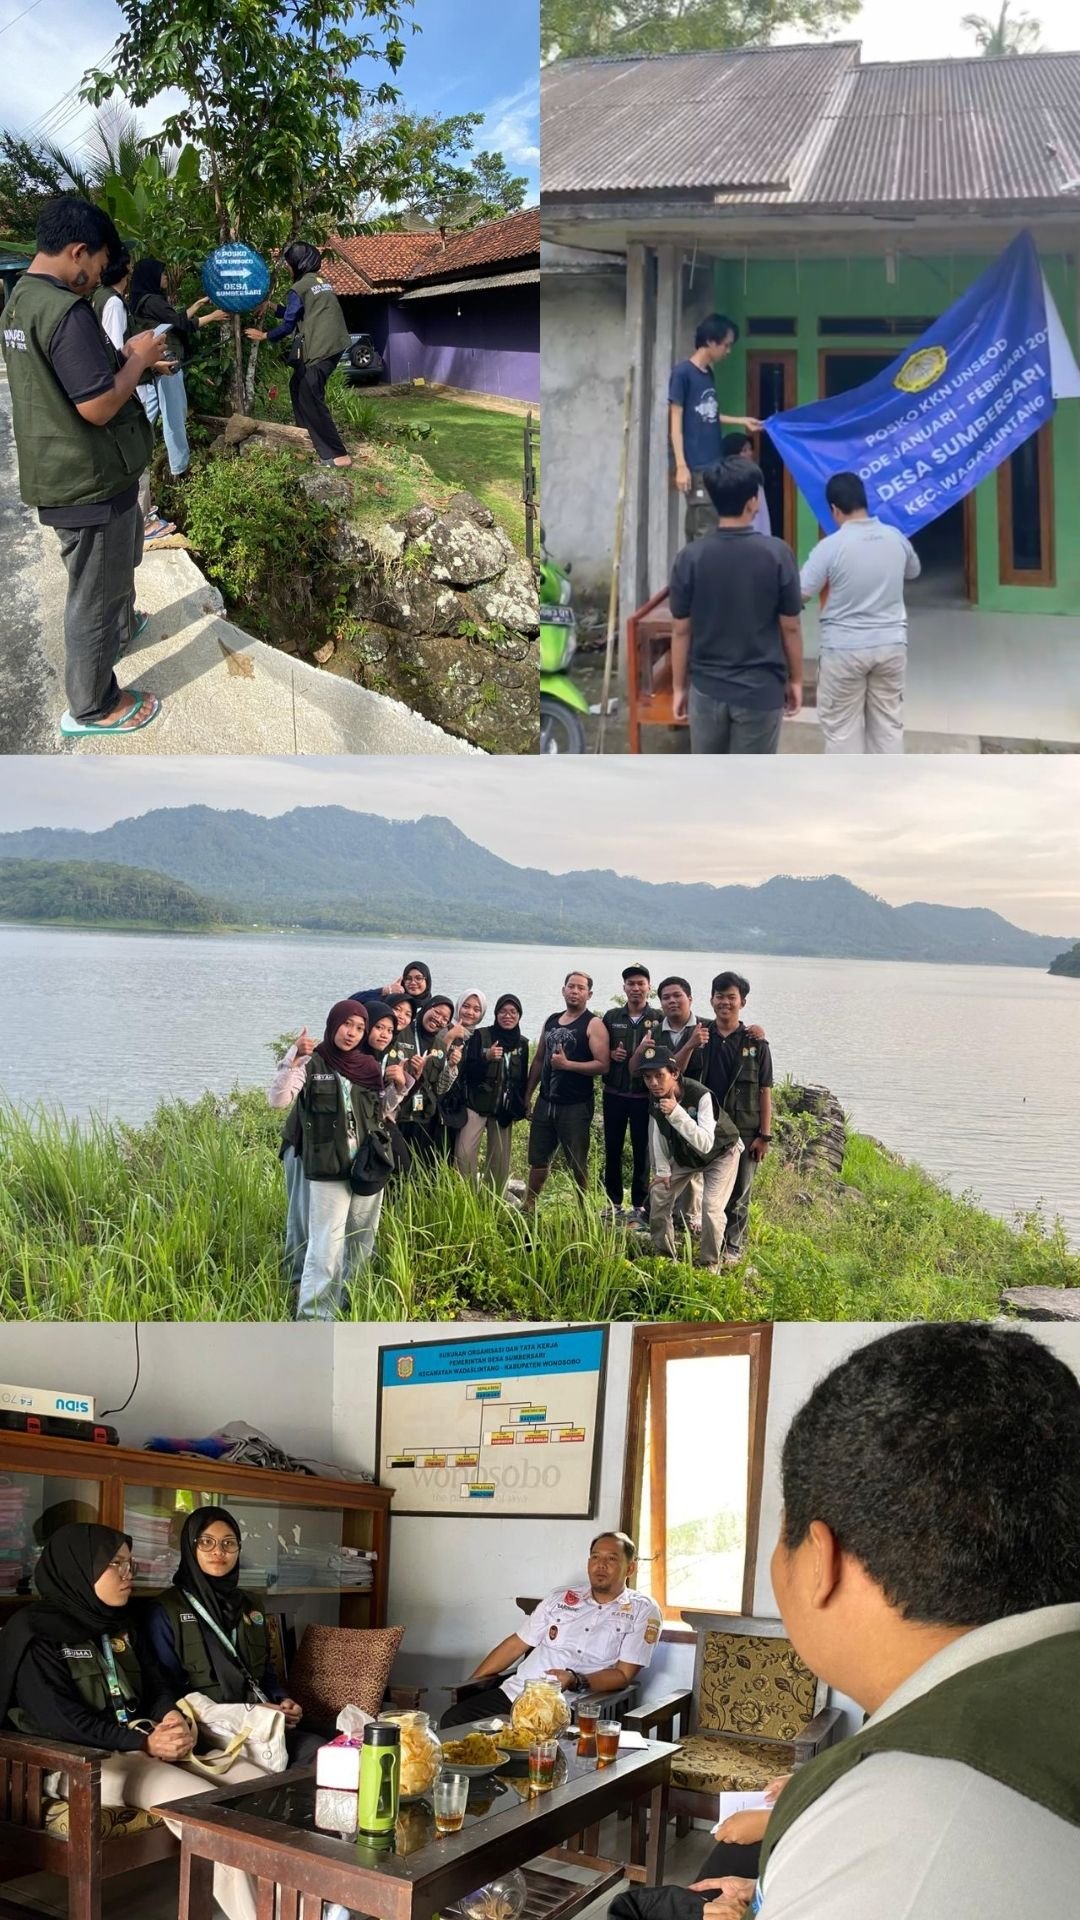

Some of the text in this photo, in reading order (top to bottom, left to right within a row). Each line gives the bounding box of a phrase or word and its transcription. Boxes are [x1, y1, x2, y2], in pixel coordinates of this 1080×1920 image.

[215, 289, 262, 297] SUMBERSARI
[856, 454, 891, 480] ODE
[893, 409, 957, 460] JANUARI
[966, 345, 1027, 405] FEBRUARI
[865, 409, 919, 447] POSKO
[919, 384, 952, 413] KKN
[876, 459, 933, 502] DESA
[931, 362, 1046, 464] SUMBERSARI
[904, 487, 942, 516] KEC.
[449, 1353, 546, 1366] PEMERINTAH DESA SUMBERSARI
[468, 1347, 505, 1356] ORGANISASI
[536, 1342, 559, 1350] KERJA
[453, 1365, 500, 1375] WADASLINTANG
[505, 1361, 541, 1371] KABUPATEN
[542, 1358, 581, 1367] WONOSOBO
[55, 1398, 89, 1413] SiDU
[412, 1457, 561, 1489] wonosobo
